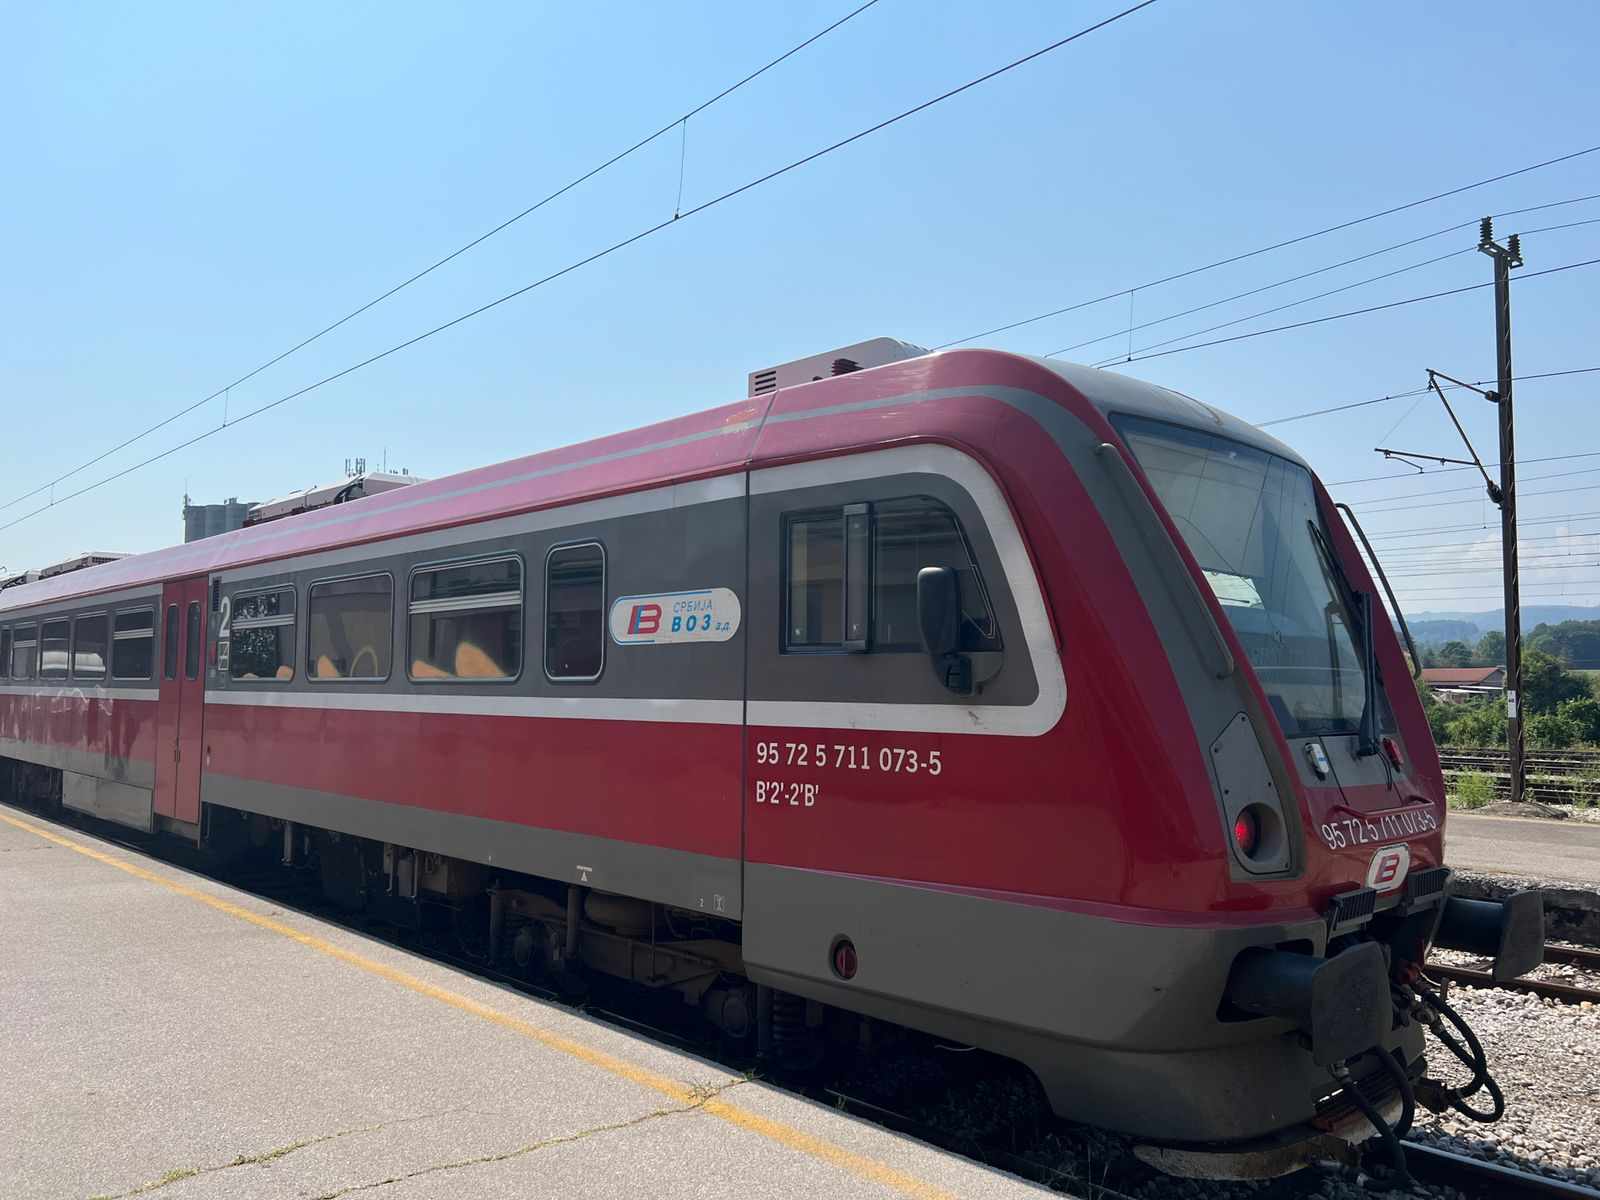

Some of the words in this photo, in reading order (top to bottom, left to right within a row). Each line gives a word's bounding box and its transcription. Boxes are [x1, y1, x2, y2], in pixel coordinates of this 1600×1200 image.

[218, 596, 231, 637] 2
[673, 599, 712, 613] СРБИЈА
[671, 613, 711, 632] ВОЗ
[756, 742, 779, 765] 95
[785, 743, 808, 766] 72
[815, 744, 827, 767] 5
[834, 745, 870, 770] 711
[879, 747, 942, 775] 073-5
[1321, 821, 1346, 850] 95
[1342, 818, 1368, 845] 72
[1366, 820, 1379, 841] 5
